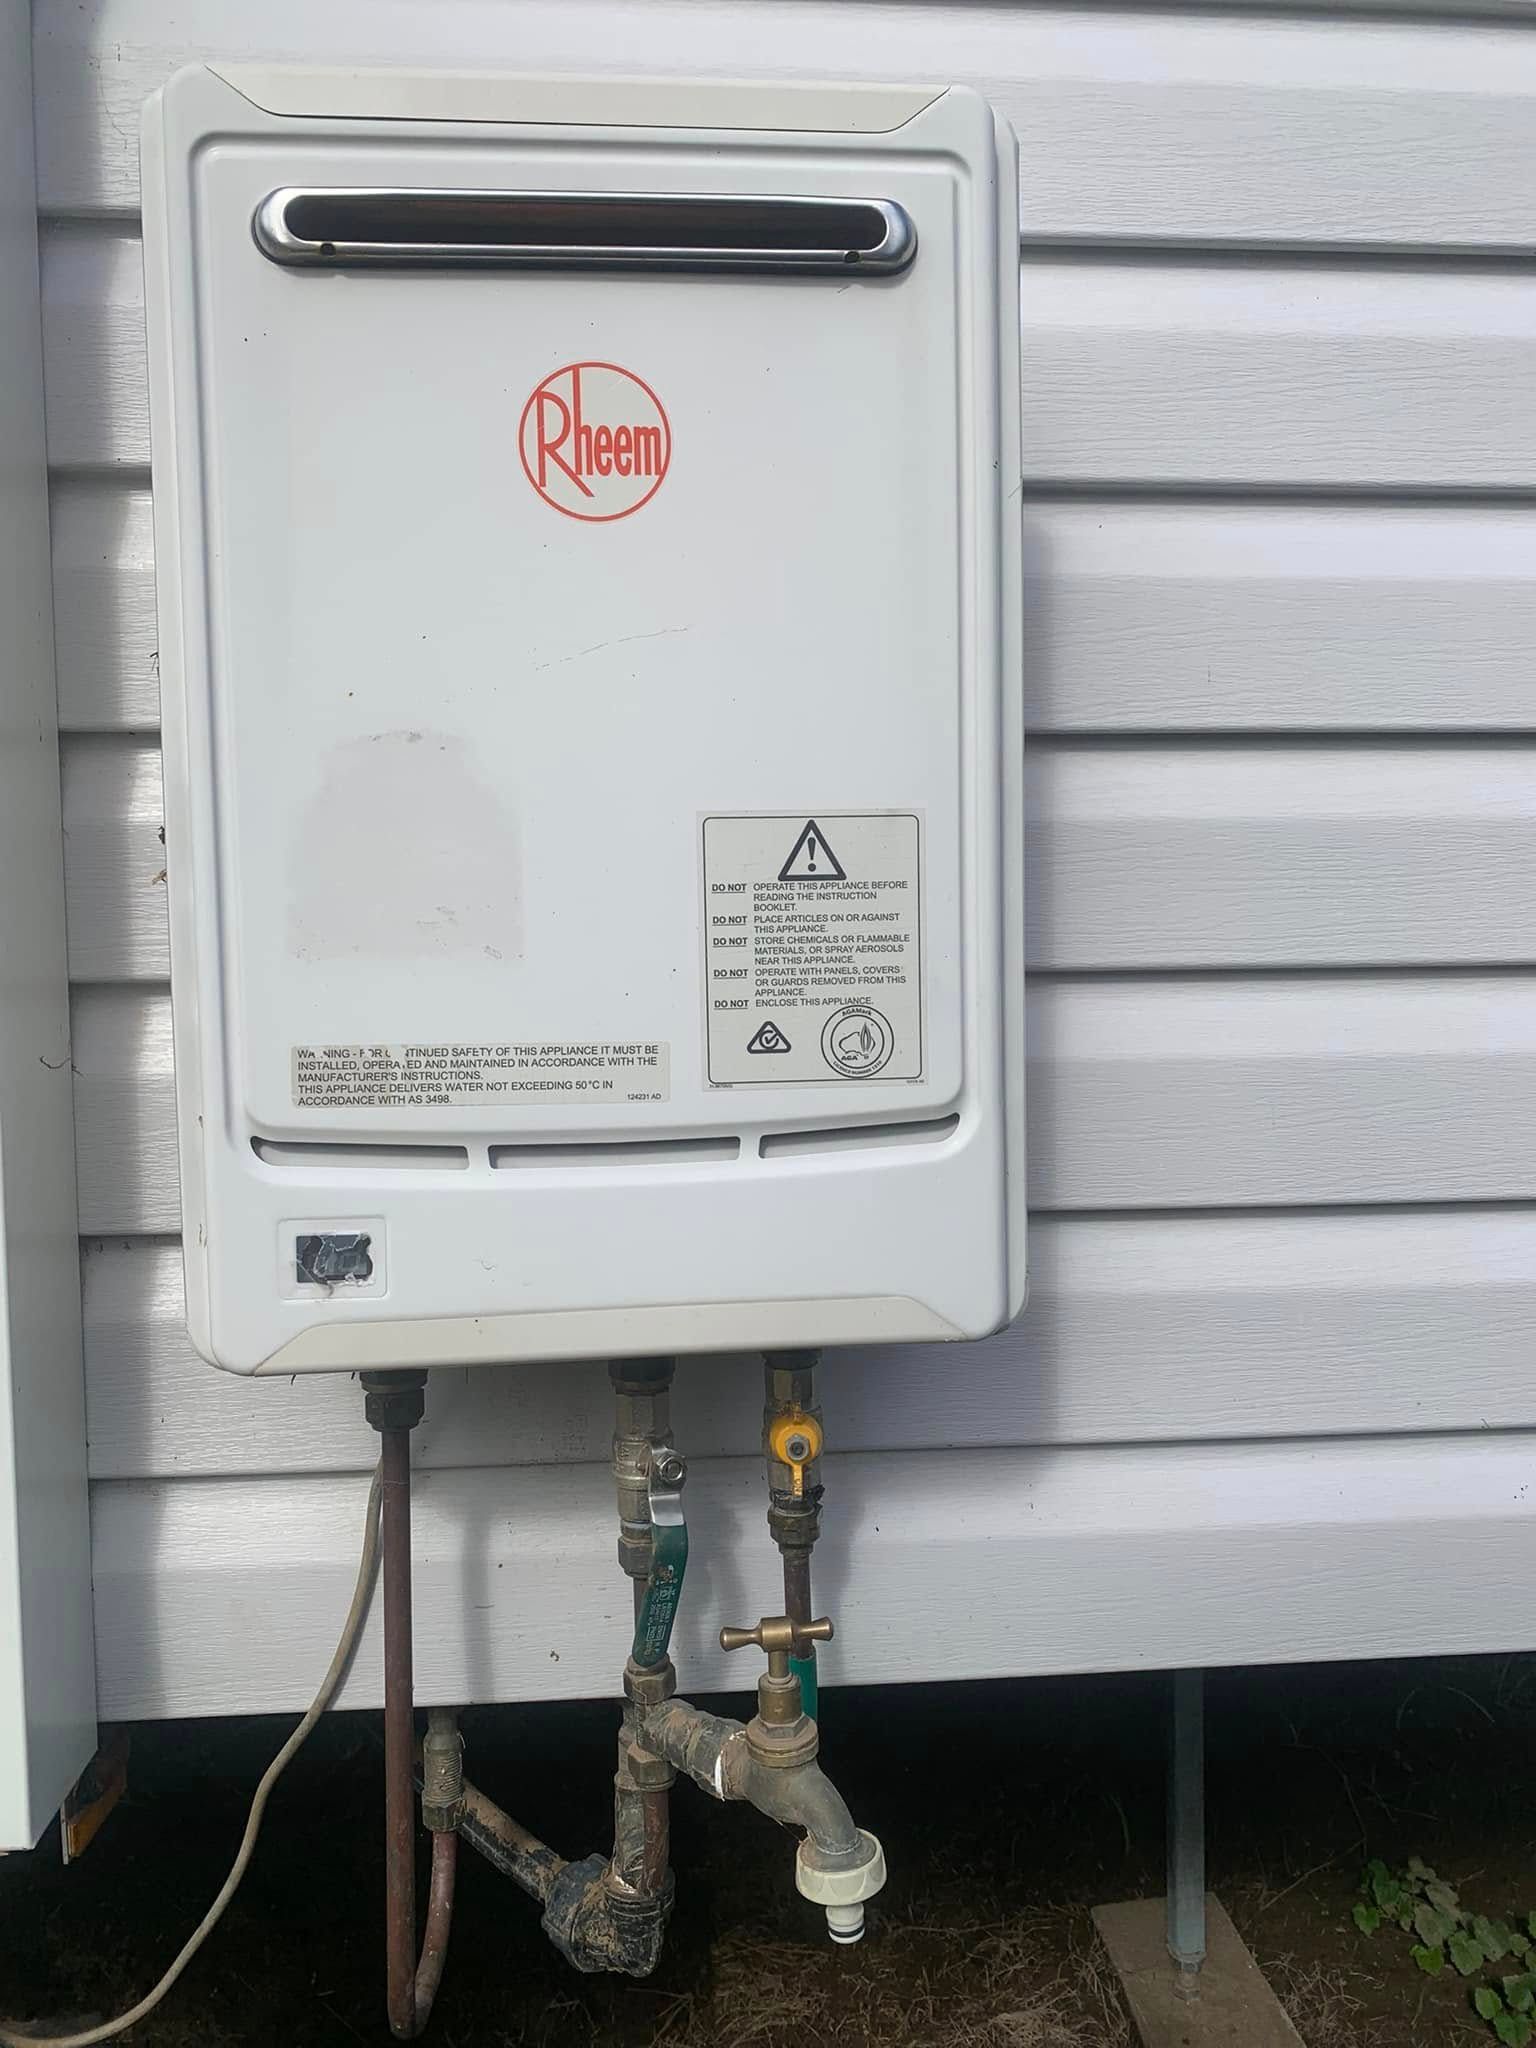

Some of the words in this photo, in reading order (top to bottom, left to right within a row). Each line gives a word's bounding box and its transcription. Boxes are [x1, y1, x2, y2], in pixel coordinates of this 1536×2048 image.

[536, 366, 663, 497] Rheem
[712, 884, 726, 892] DO
[754, 883, 795, 891] OPERATE
[872, 881, 908, 889] BEFORE
[754, 893, 794, 901] READING
[817, 892, 877, 900] INSTRUCTION
[754, 915, 783, 923] PLACE
[785, 914, 828, 922] ARTICLES
[830, 914, 844, 922] ON
[861, 913, 899, 921] AGAINST
[754, 925, 774, 933] THIS
[776, 925, 828, 933] APPLIANCE.
[729, 937, 747, 945] NOT
[755, 936, 785, 944] STORE
[787, 936, 838, 944] CHEMICALS
[857, 935, 909, 943] FLAMMABLE
[755, 947, 806, 956] MATERIALS,
[809, 946, 823, 954] OR
[856, 945, 904, 953] AEROSOLS
[755, 957, 780, 965] NEAR
[804, 956, 855, 964] APPLIANCE.
[714, 969, 728, 977] DO
[730, 969, 748, 977] NOT
[755, 968, 797, 976] OPERATE
[824, 967, 860, 976] PANELS,
[863, 966, 899, 974] COVERS
[771, 978, 809, 986] GUARDS
[811, 977, 855, 985] REMOVED
[857, 976, 884, 984] FROM
[755, 988, 807, 997] APPLIANCE.
[756, 999, 798, 1007] ENCLOSE
[800, 998, 820, 1006] THIS
[822, 997, 874, 1005] APPLIANCE.
[452, 1047, 492, 1057] SAFETY
[496, 1048, 510, 1056] OF
[513, 1047, 537, 1055] THIS
[540, 1046, 598, 1055] APPLIANCE
[601, 1046, 610, 1054] IT
[613, 1046, 642, 1054] MUST
[645, 1045, 658, 1053] BE
[298, 1061, 359, 1071] INSTALLED,
[363, 1060, 421, 1069] OPERAED
[425, 1060, 448, 1068] AND
[450, 1058, 515, 1068] MAINTAINED
[519, 1059, 528, 1067] IN
[531, 1058, 605, 1067] ACCORDANCE
[608, 1058, 634, 1066] WITH
[637, 1057, 657, 1065] THE
[298, 1072, 398, 1082] MANUFACTURER'S
[401, 1071, 483, 1081] INSTRUCTIONS.
[298, 1085, 322, 1093] THIS
[326, 1084, 386, 1093] APPLIANCE
[389, 1083, 442, 1092] DELIVERS
[445, 1082, 483, 1091] WATER
[487, 1082, 508, 1090] NOT
[512, 1081, 573, 1090] EXCEEDING
[603, 1081, 612, 1089] IN
[298, 1096, 375, 1105] ACCORDANCE
[378, 1096, 405, 1104] WITH
[426, 1095, 452, 1103] 3498.
